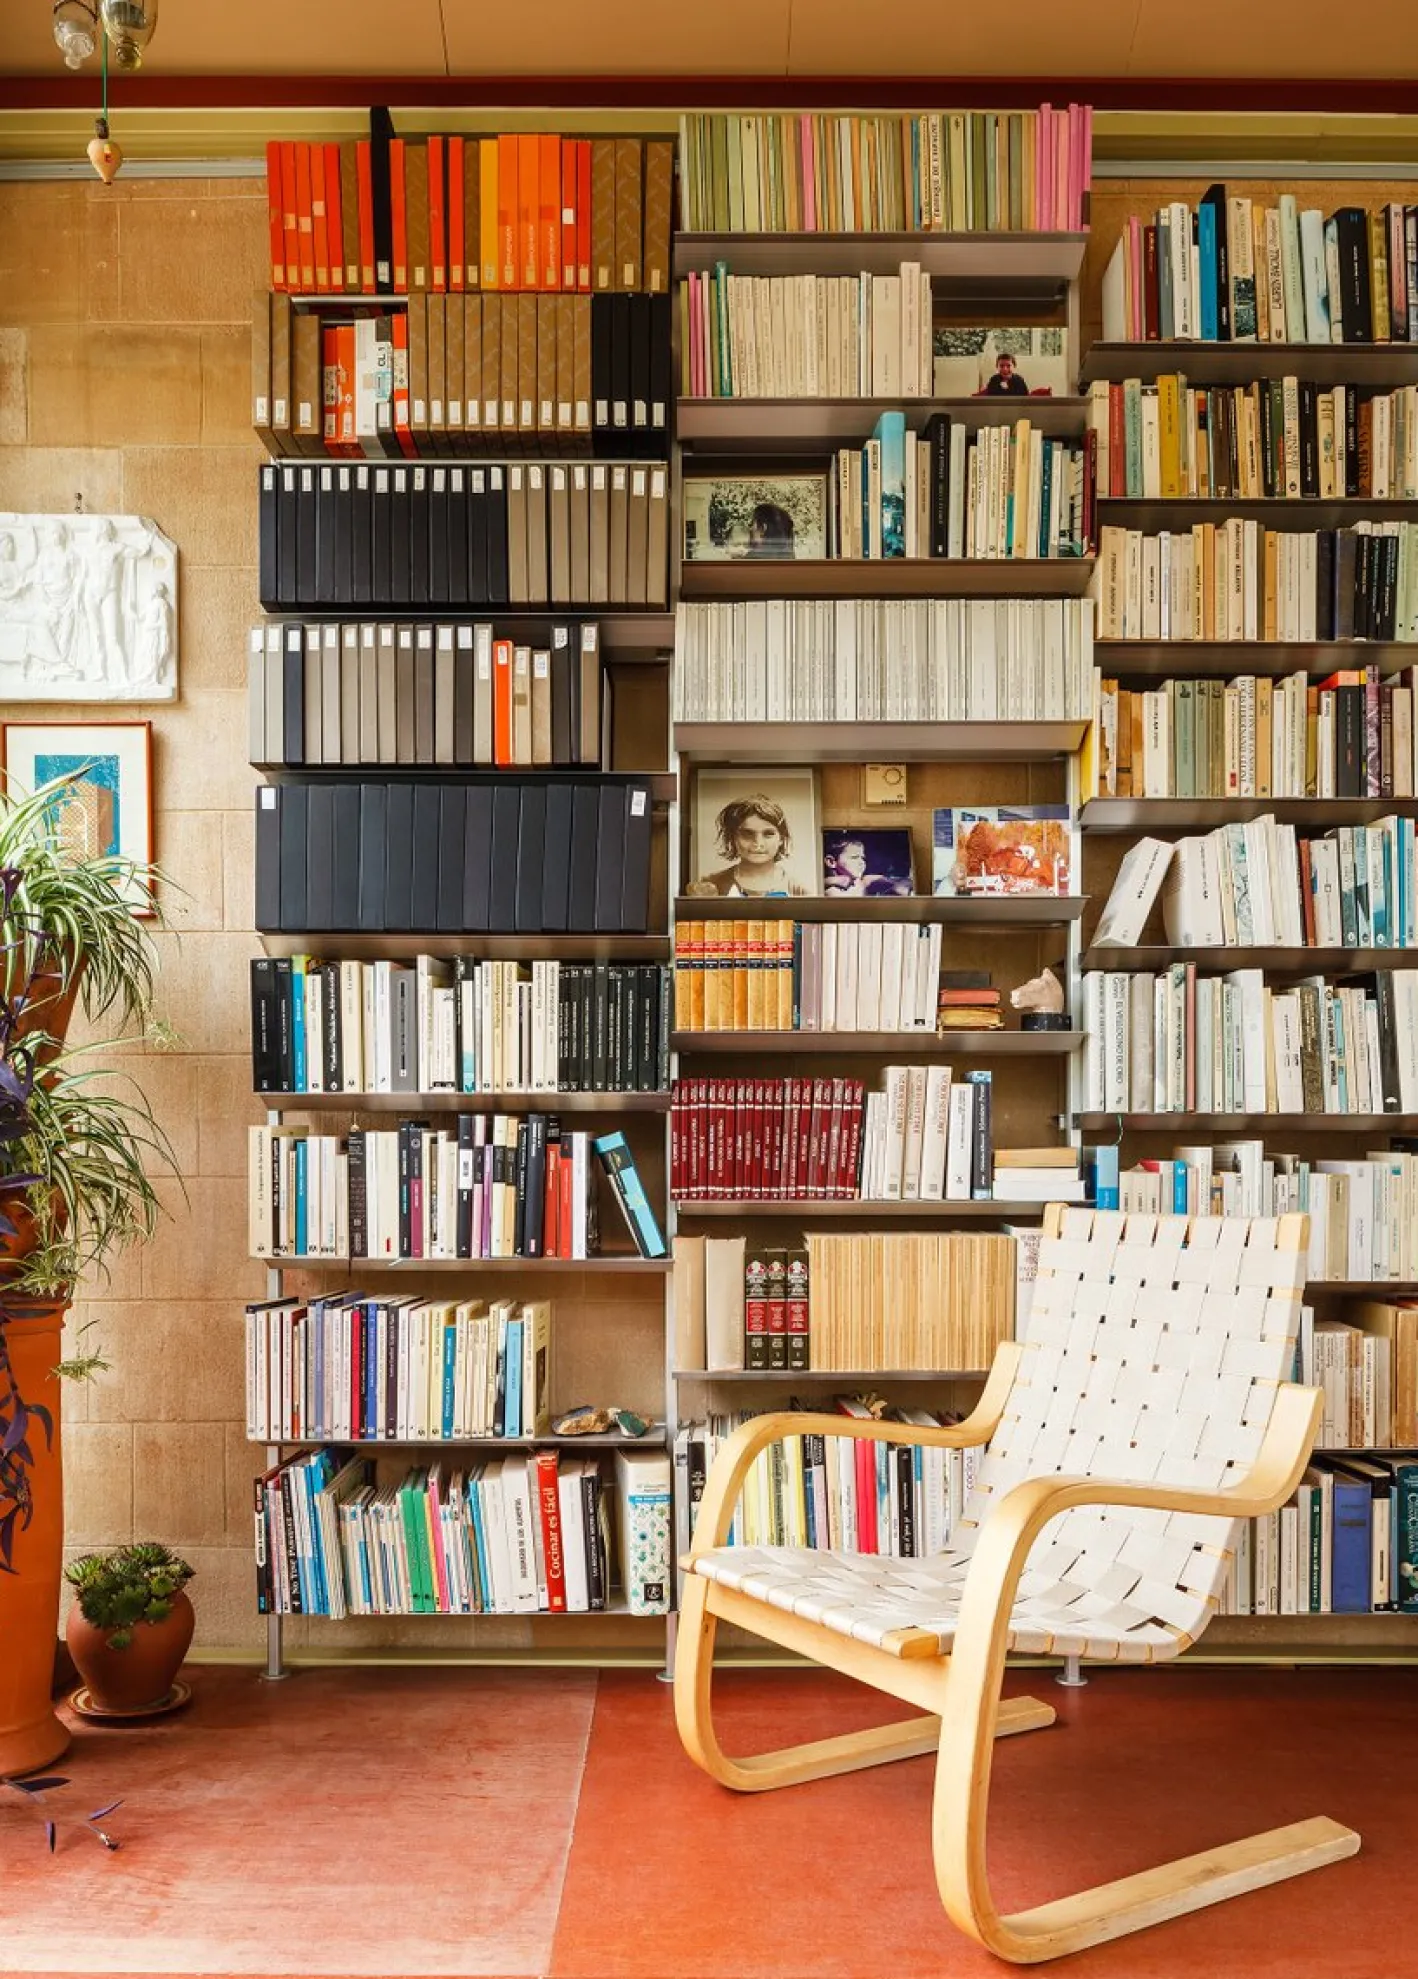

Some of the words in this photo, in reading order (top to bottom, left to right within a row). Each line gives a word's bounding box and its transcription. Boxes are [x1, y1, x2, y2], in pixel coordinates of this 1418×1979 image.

[1116, 1056, 1123, 1064] DE
[966, 1456, 974, 1490] cocina
[543, 1487, 556, 1513] fácil
[547, 1516, 558, 1528] es
[546, 1531, 561, 1578] Cocinar
